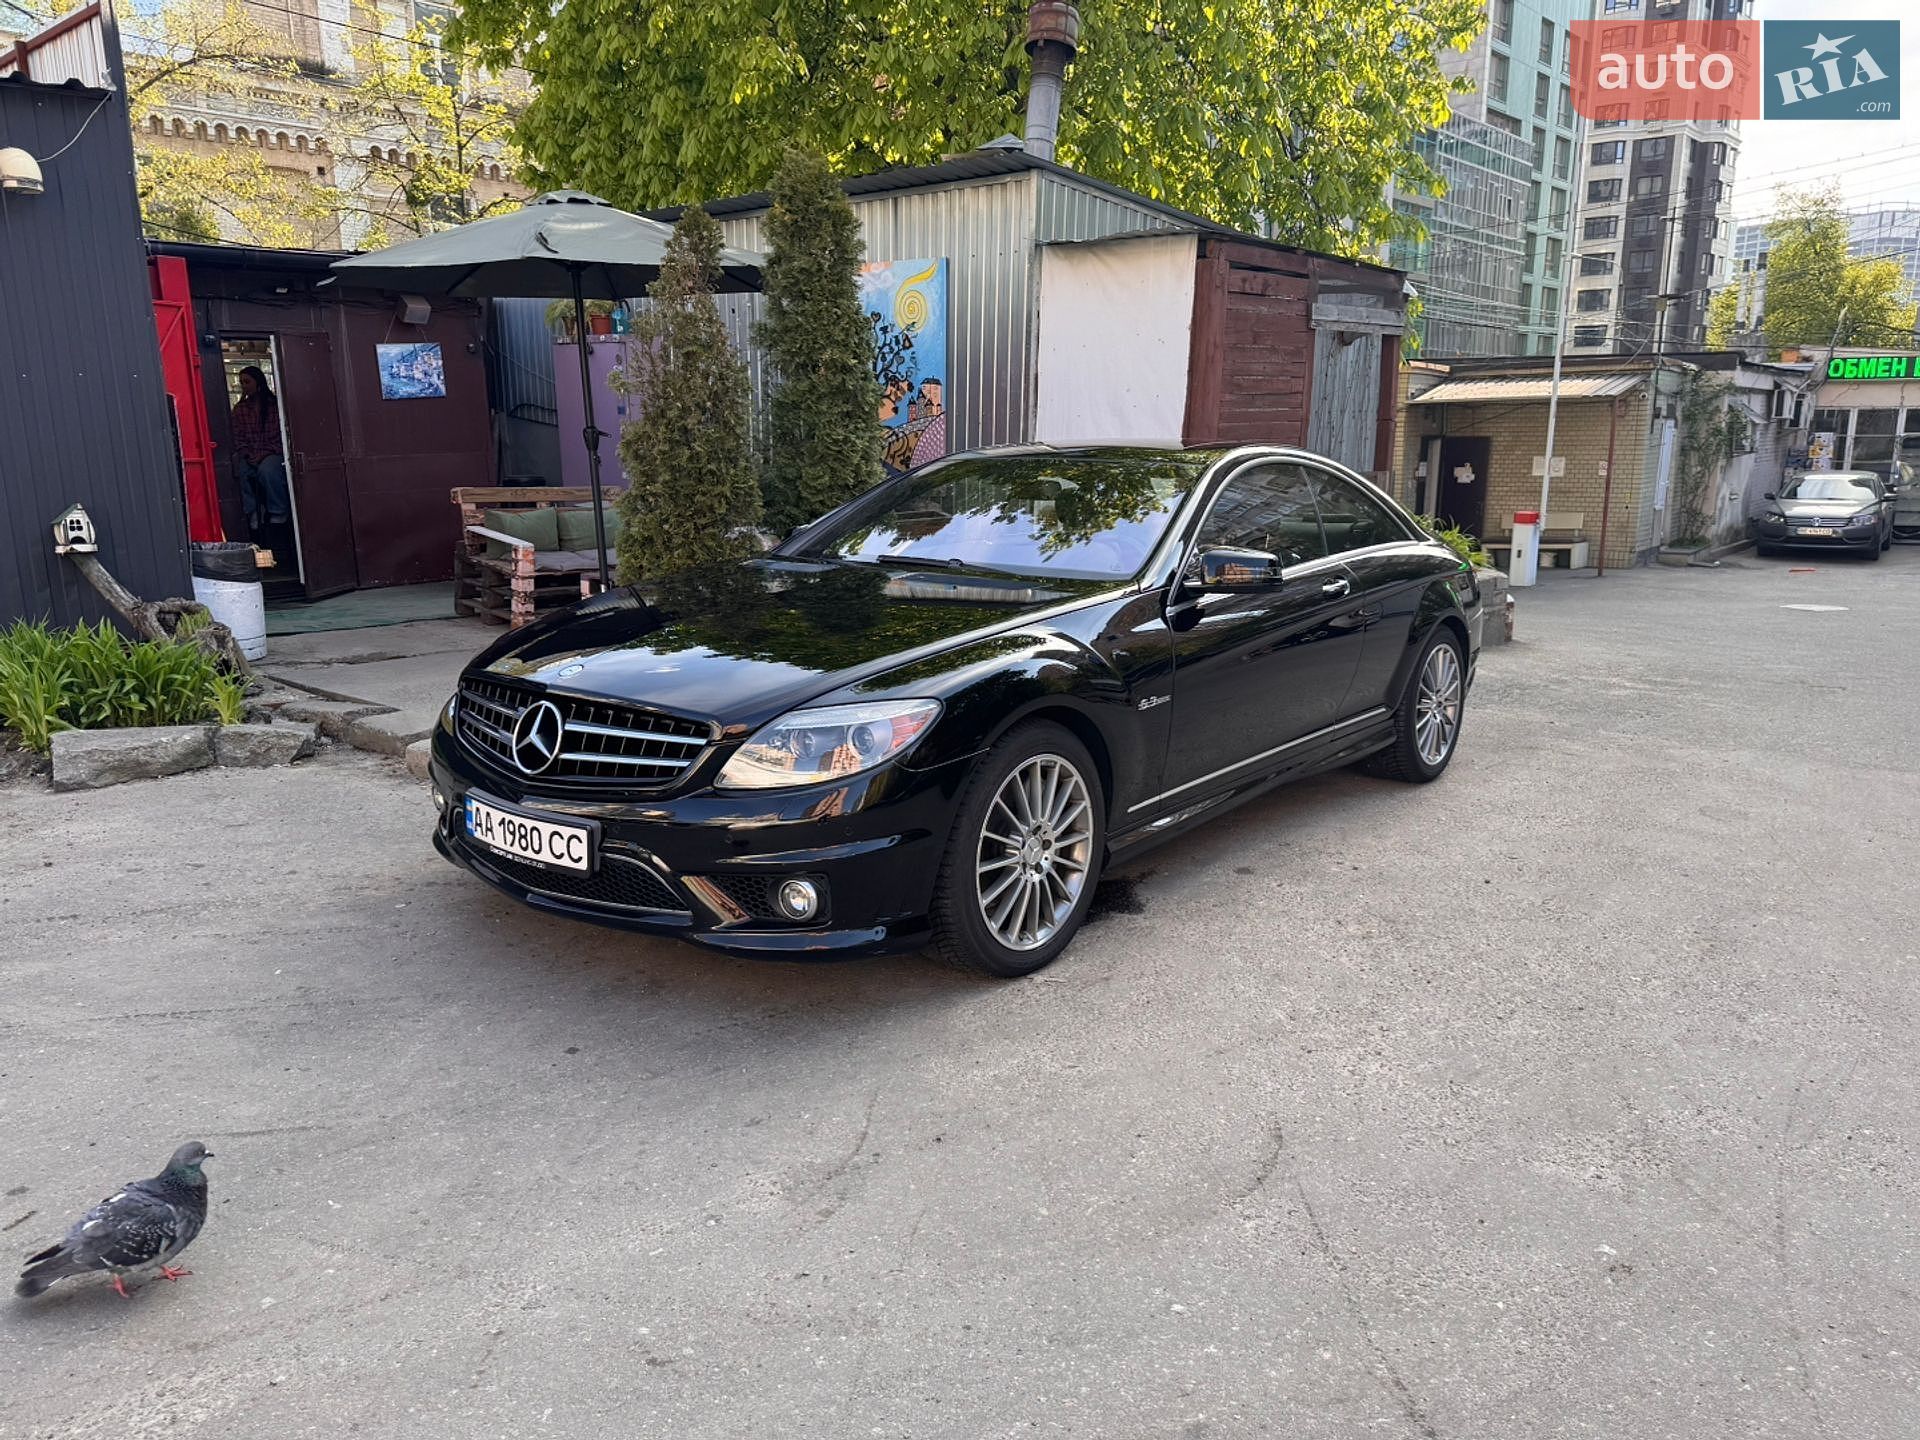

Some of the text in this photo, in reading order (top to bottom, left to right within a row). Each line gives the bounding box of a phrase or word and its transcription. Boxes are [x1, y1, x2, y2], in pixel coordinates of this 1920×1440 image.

[1828, 357, 1908, 378] ОБМЕН
[474, 806, 496, 841] AA
[498, 816, 543, 855] 1980
[549, 830, 584, 864] CC
